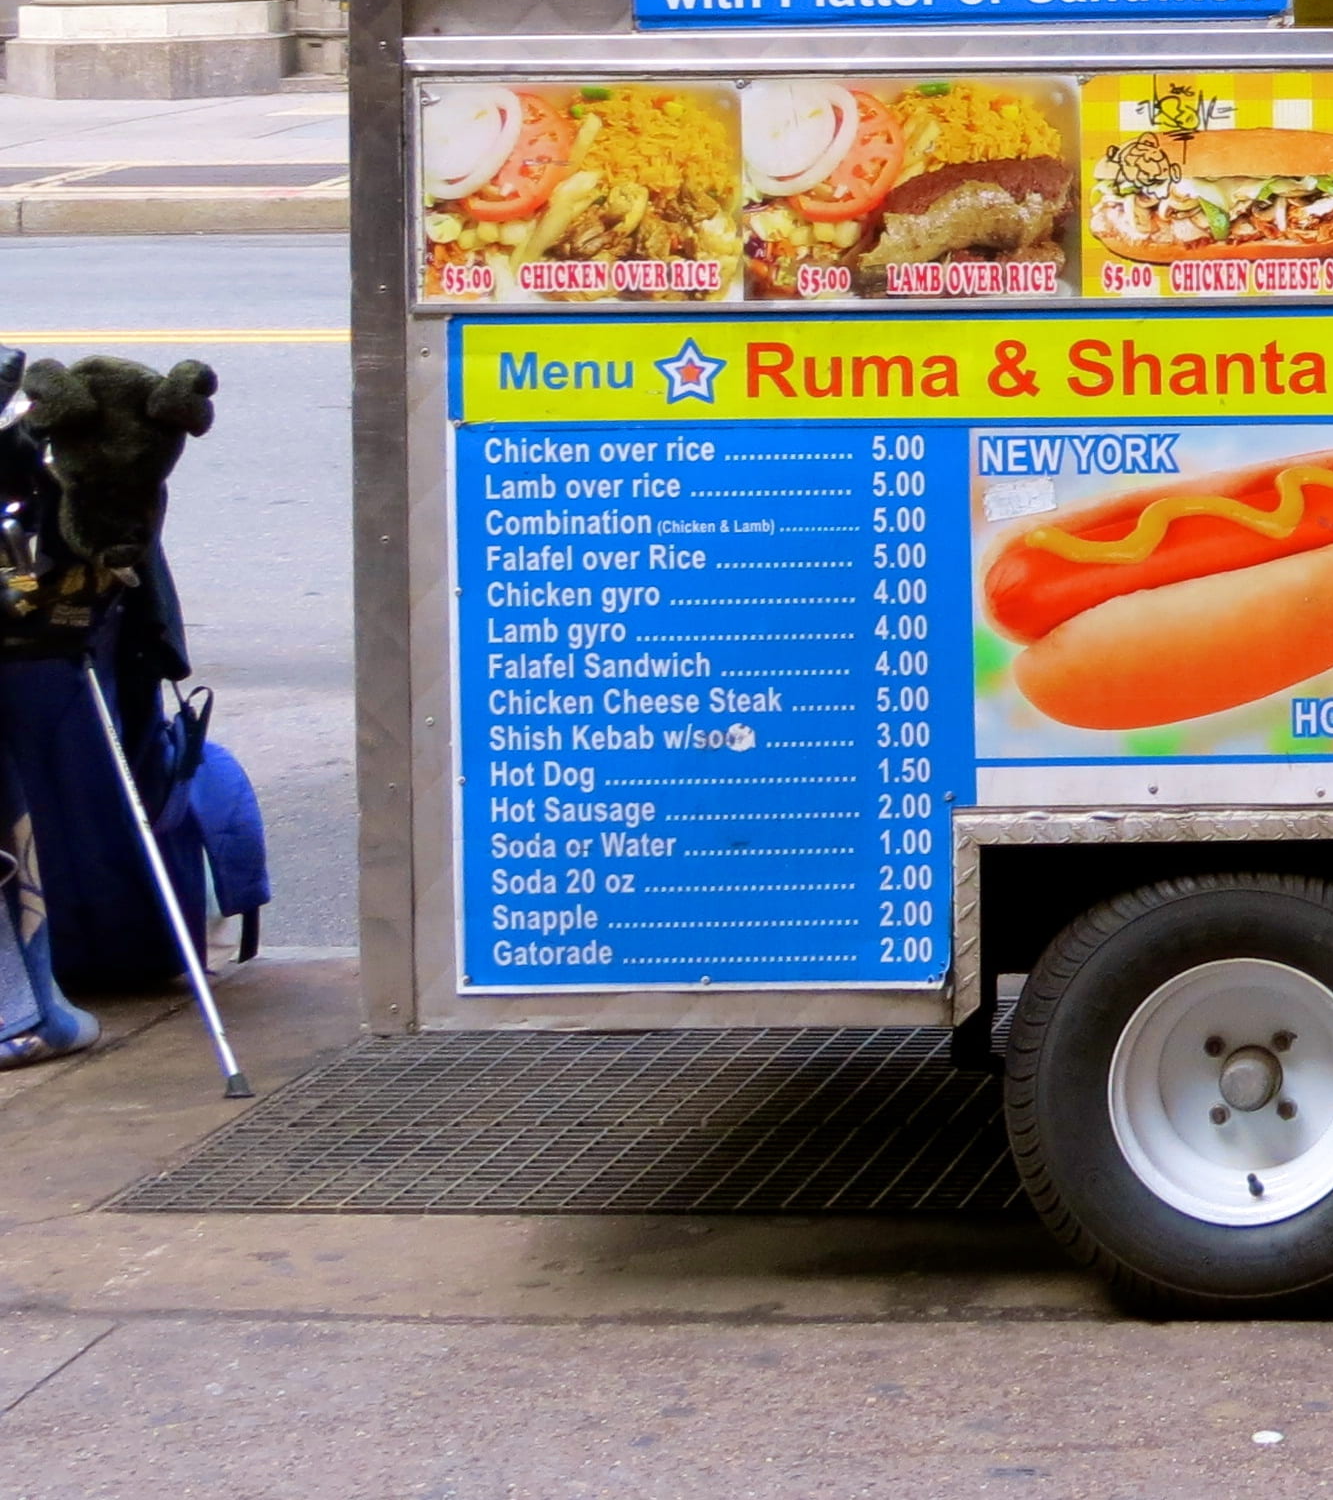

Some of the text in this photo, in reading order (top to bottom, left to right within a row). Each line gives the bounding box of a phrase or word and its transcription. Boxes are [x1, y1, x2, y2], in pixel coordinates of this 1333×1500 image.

[444, 261, 720, 292] $5.00 CHICKEN OVER RICE
[799, 263, 1055, 295] $5.00 LAMB OVER RICE
[1102, 266, 1152, 290] $5.00
[1170, 264, 1248, 291] CHICKEN
[1254, 263, 1318, 290] CHEESE
[500, 352, 634, 390] Menu
[747, 342, 959, 397] Ruma
[987, 340, 1039, 396] &
[1066, 338, 1329, 398] Shanta
[484, 436, 924, 464] Chicken over rice 5.00
[979, 434, 1179, 475] NEW YORK
[485, 471, 925, 499] Lamb over rice 5.00
[485, 508, 926, 536] Combination (Chicken & Lamb) 5.00
[486, 543, 926, 571] Falafel over Rice 5.00
[487, 579, 927, 612] Chicken gyro 4.00
[488, 616, 927, 649] Lamb gyro 4.00
[489, 651, 928, 679] Falafel Sandwich 4.00
[489, 687, 929, 715] Chicken Cheese Steak 5.00
[489, 726, 565, 752] Shish
[573, 725, 654, 751] Kebab
[877, 722, 929, 747] 3.00
[491, 758, 930, 793] Hot Dog 1.50
[491, 794, 931, 828] Hot Sausage 2.00
[491, 830, 931, 859] Soda or Water 1.00
[491, 866, 932, 894] Soda 20 oz 2.00
[492, 902, 933, 936] Snapple 2.00
[493, 937, 933, 967] Gatorade 2.00
